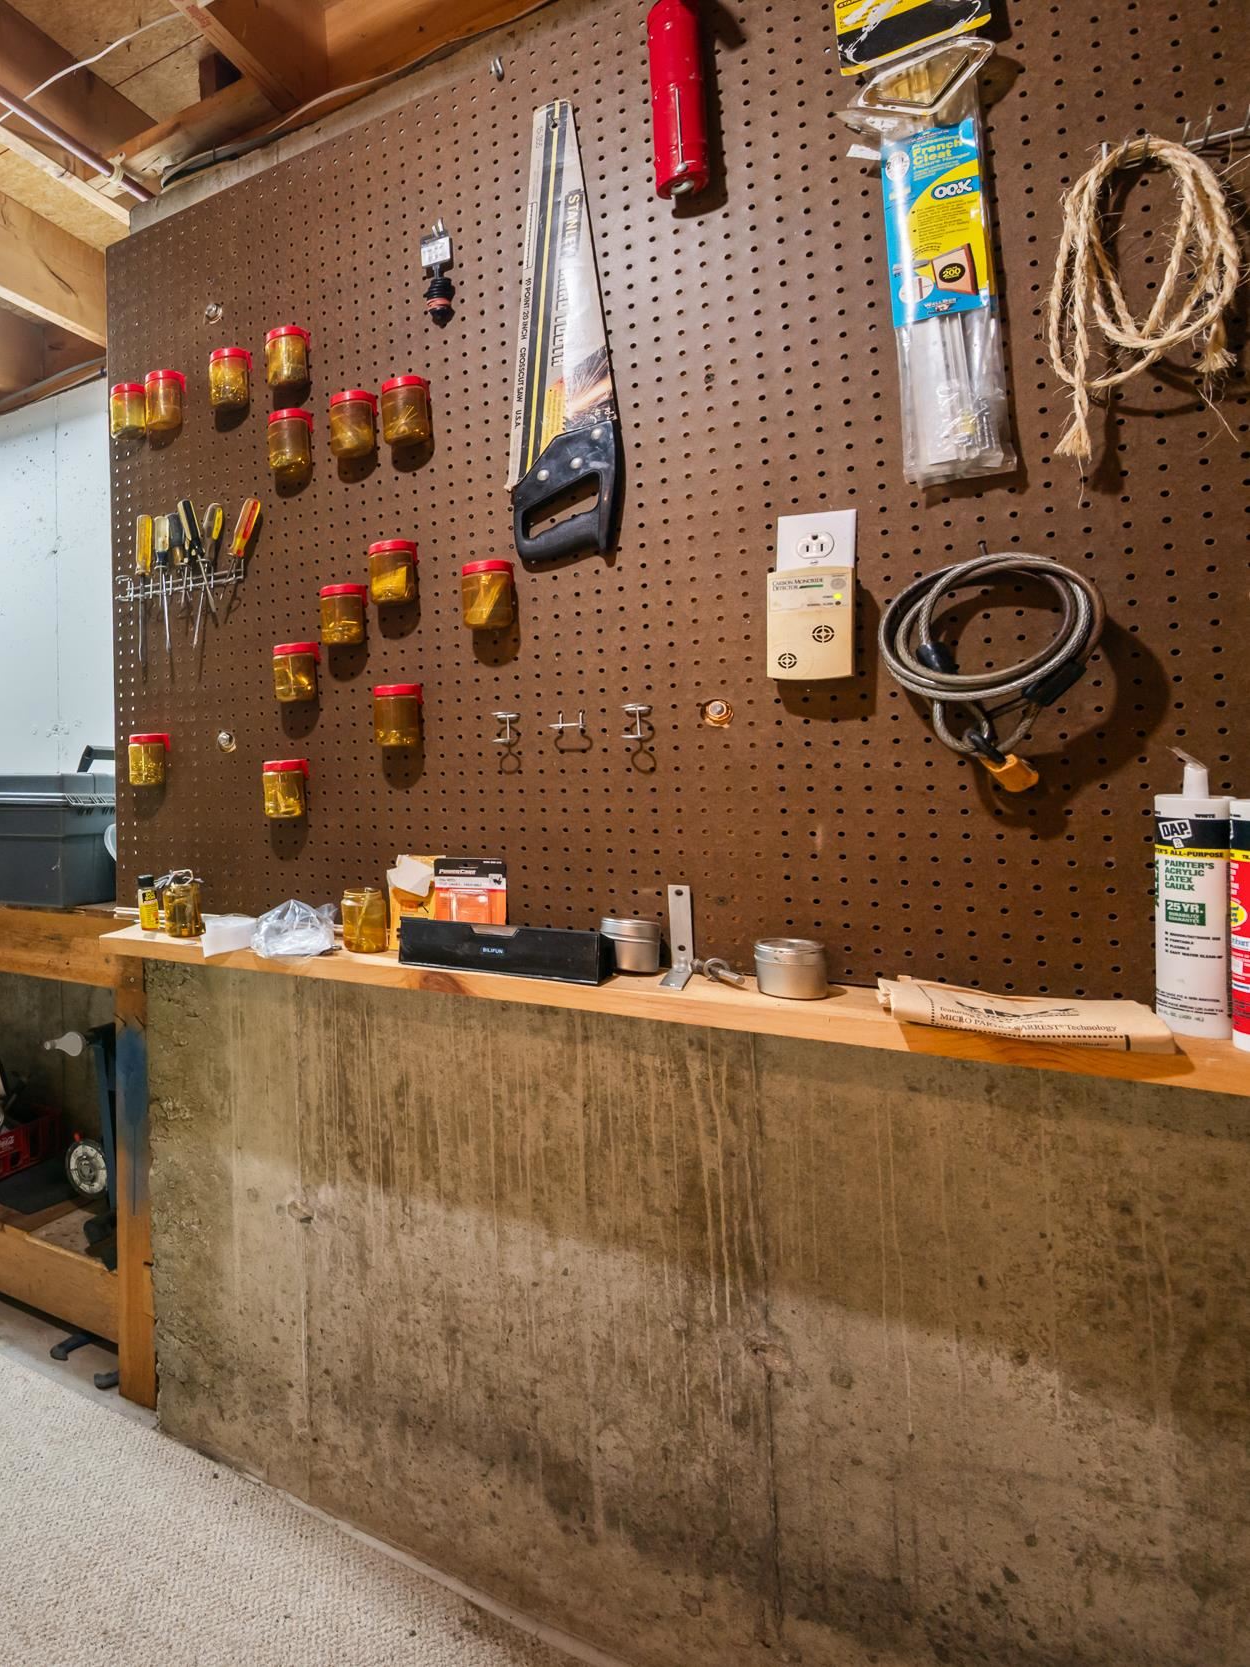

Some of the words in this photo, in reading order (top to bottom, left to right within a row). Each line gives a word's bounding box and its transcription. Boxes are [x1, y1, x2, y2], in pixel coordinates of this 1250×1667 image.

[911, 138, 963, 158] French
[913, 148, 953, 166] Cleat
[933, 178, 973, 199] OOK
[562, 193, 582, 256] STANLEY
[941, 266, 962, 279] 200
[519, 321, 528, 341] INCH
[517, 346, 528, 387] CROSSCUT
[514, 385, 524, 403] SAW
[1170, 850, 1224, 858] ALL-PURPOSE
[1164, 859, 1215, 870] PAINTER'S
[1164, 866, 1205, 877] ACRYLIC
[1164, 874, 1193, 884] LATEX
[1164, 882, 1196, 892] CAULK
[1166, 902, 1180, 911] 25
[1181, 903, 1204, 914] YR.
[940, 1013, 973, 1024] MICRO
[1065, 1024, 1118, 1033] Technology
